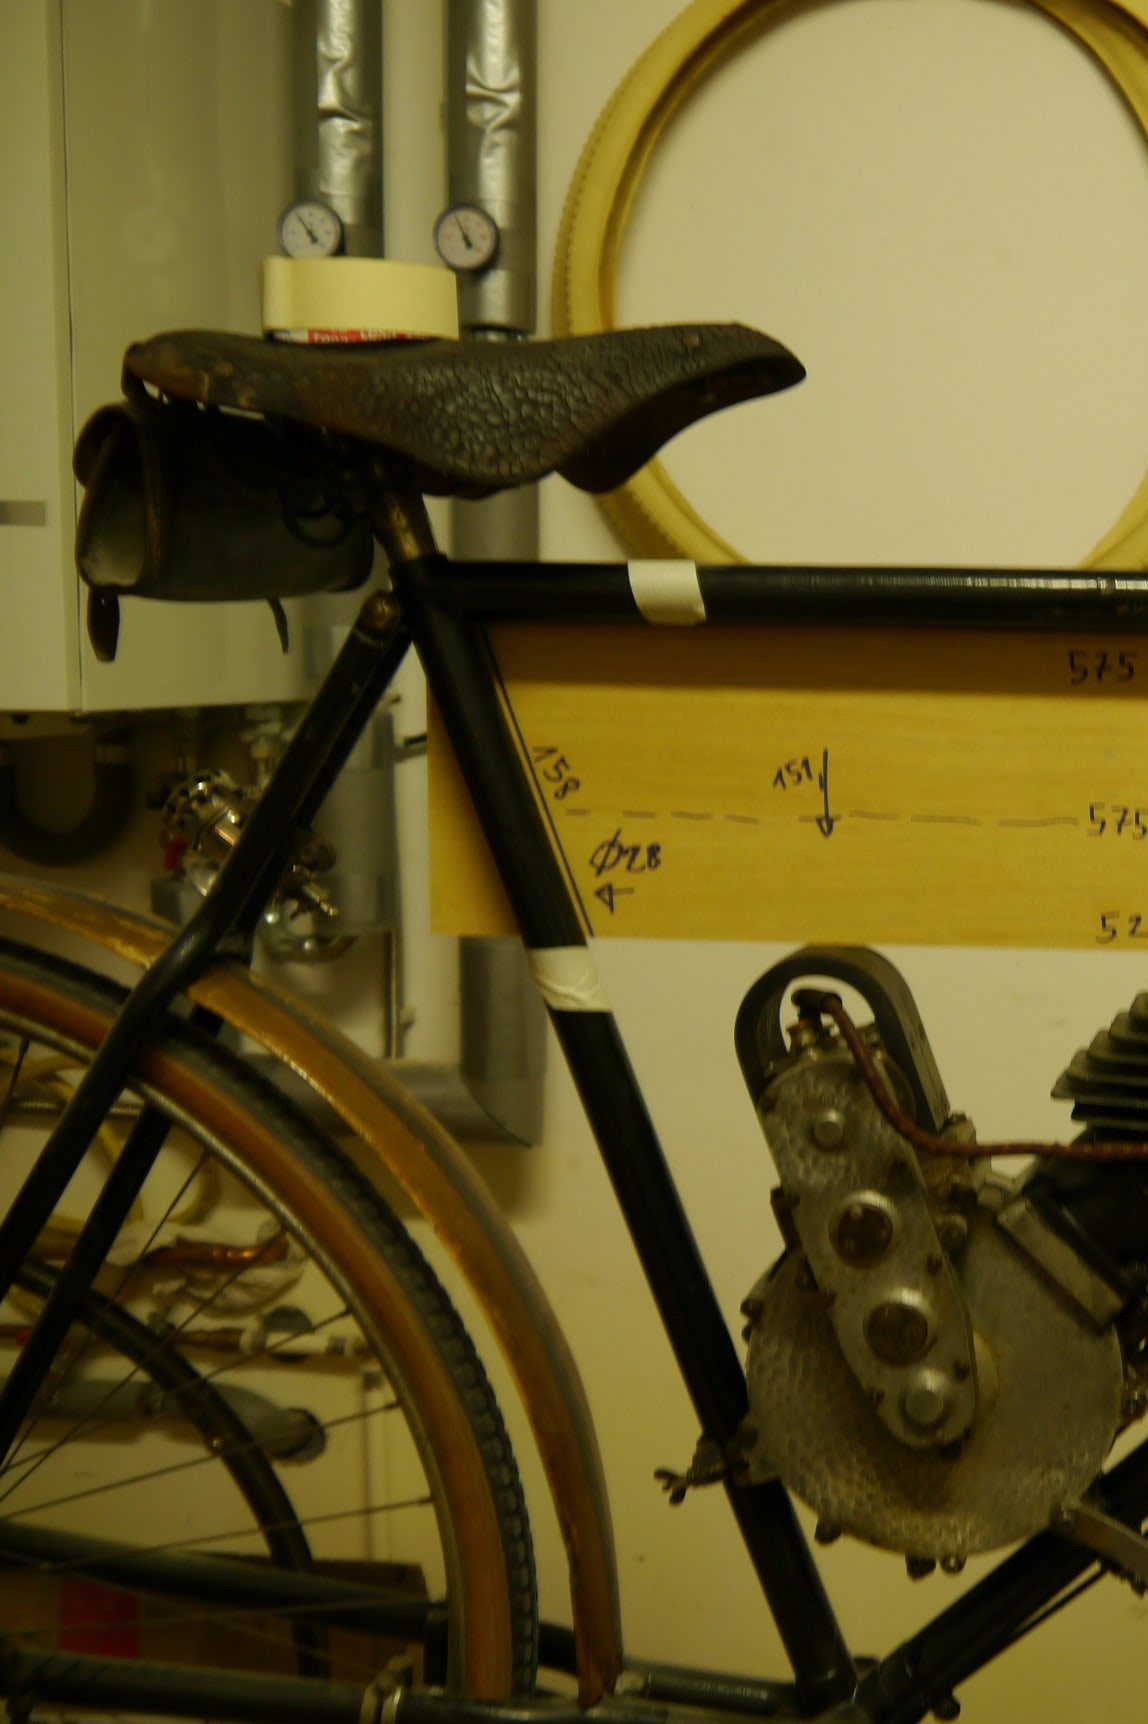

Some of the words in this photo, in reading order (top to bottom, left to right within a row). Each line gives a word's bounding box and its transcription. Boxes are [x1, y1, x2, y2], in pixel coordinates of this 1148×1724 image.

[1069, 651, 1138, 686] 575
[532, 746, 580, 800] 158
[1088, 803, 1148, 840] 575
